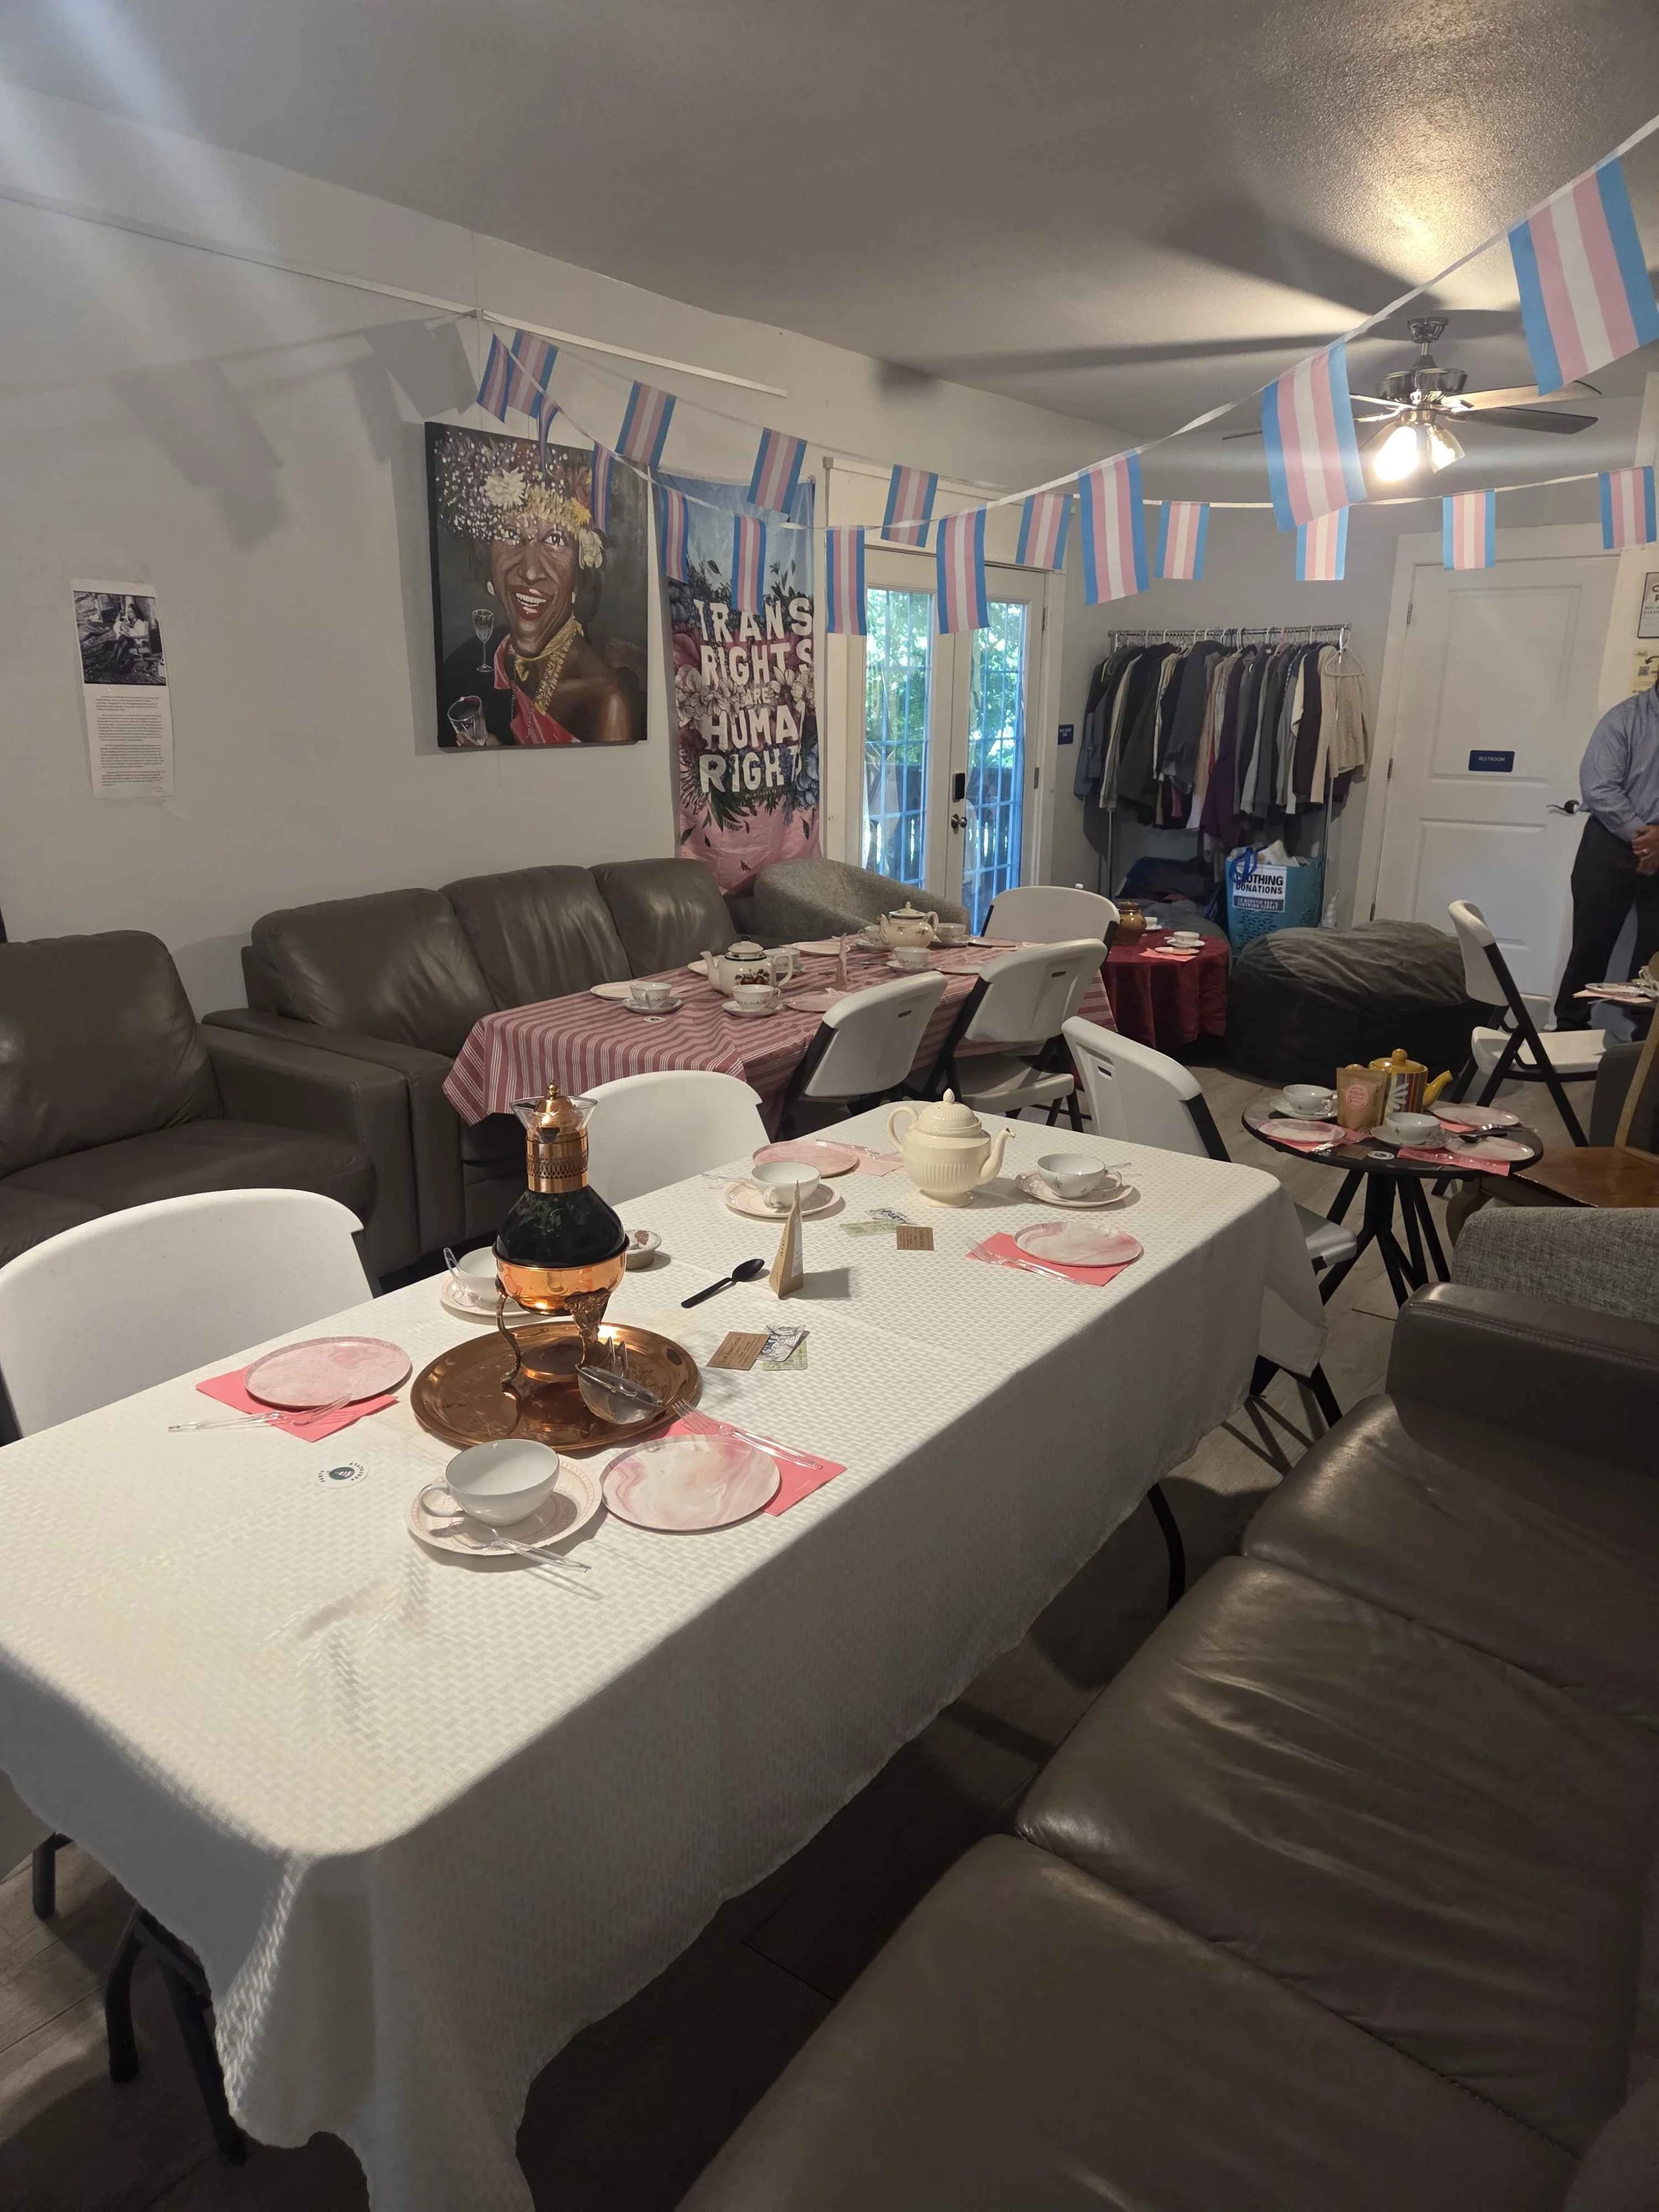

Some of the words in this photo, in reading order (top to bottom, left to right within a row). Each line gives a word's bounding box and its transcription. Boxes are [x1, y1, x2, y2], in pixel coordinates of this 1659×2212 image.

[693, 597, 814, 642] TRANS
[700, 638, 814, 689] RIGHTS
[745, 687, 771, 705] ARE
[701, 701, 805, 752] HUMA
[1236, 883, 1283, 895] DONATIONS
